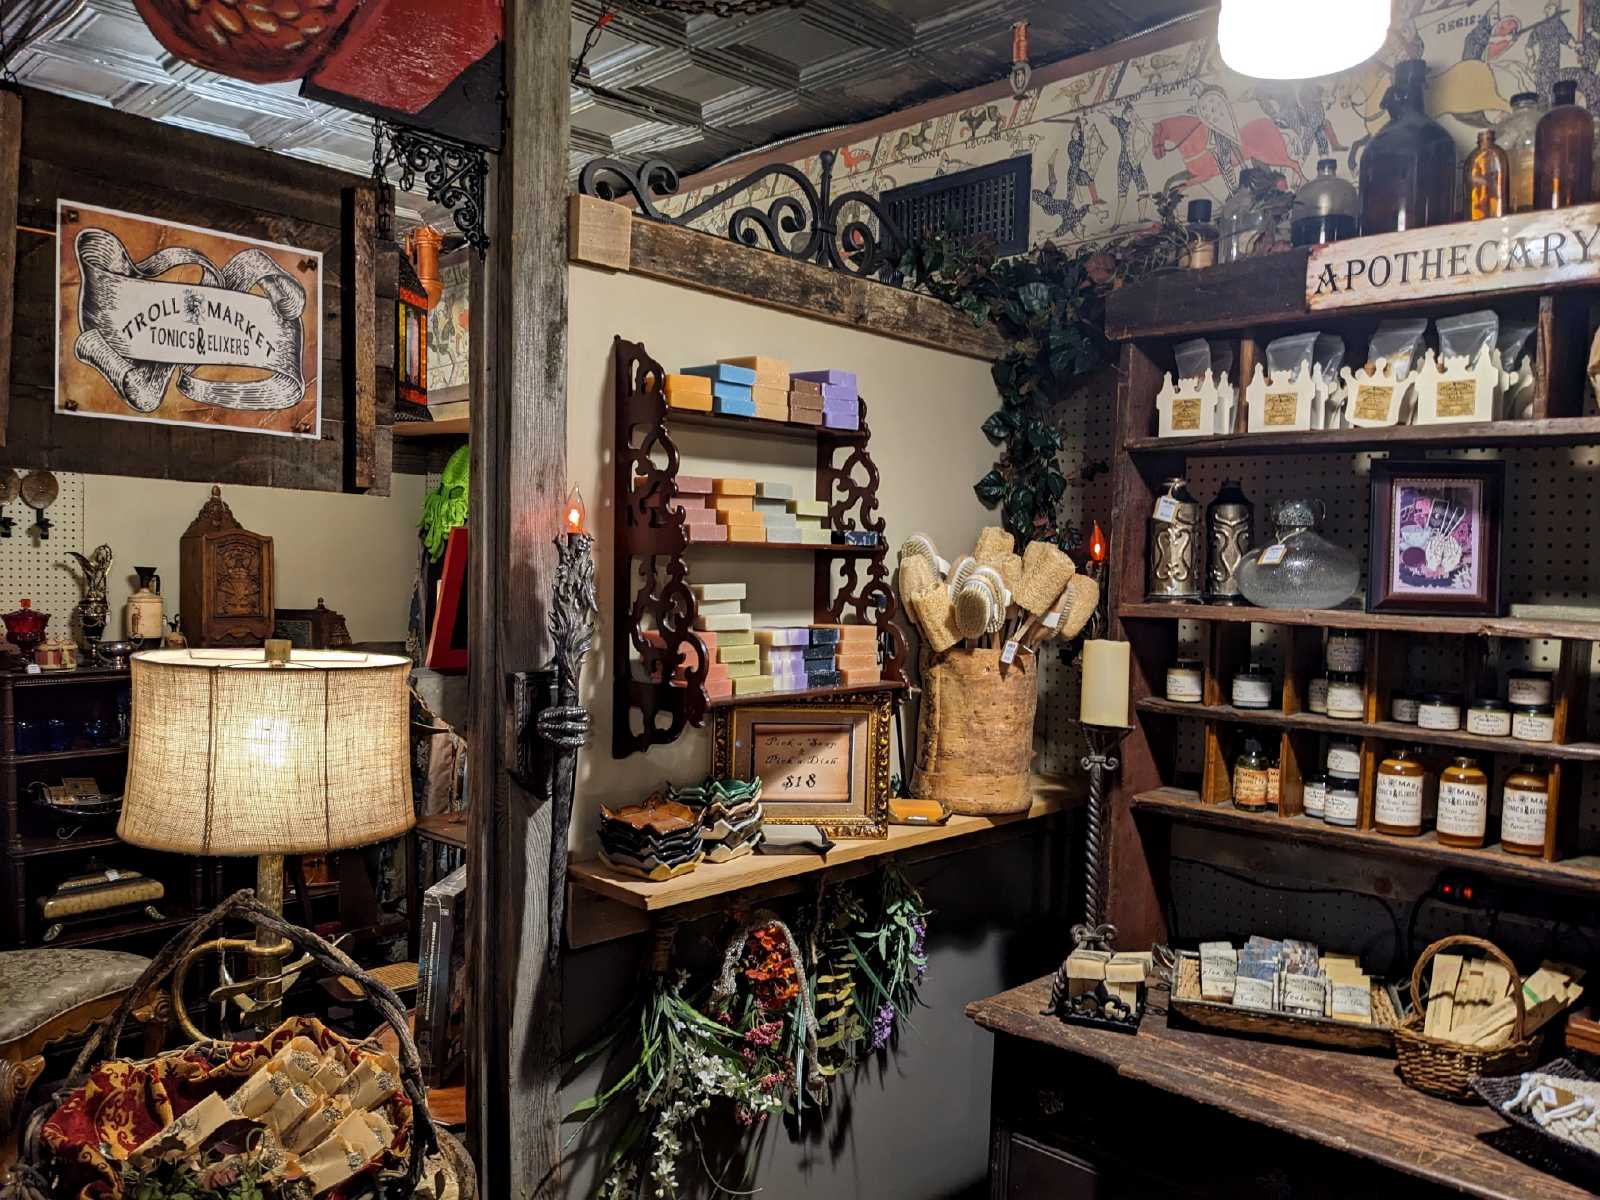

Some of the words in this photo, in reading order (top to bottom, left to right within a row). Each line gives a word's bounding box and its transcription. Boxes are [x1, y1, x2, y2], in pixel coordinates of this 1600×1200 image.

[1314, 224, 1600, 295] APOTHECARY
[122, 297, 180, 341] TROLL
[207, 300, 275, 358] MARKET
[150, 325, 195, 350] TONICS
[196, 327, 206, 357] &
[207, 334, 250, 357] ELIXERS
[764, 755, 793, 766] Pick
[782, 773, 817, 791] $18
